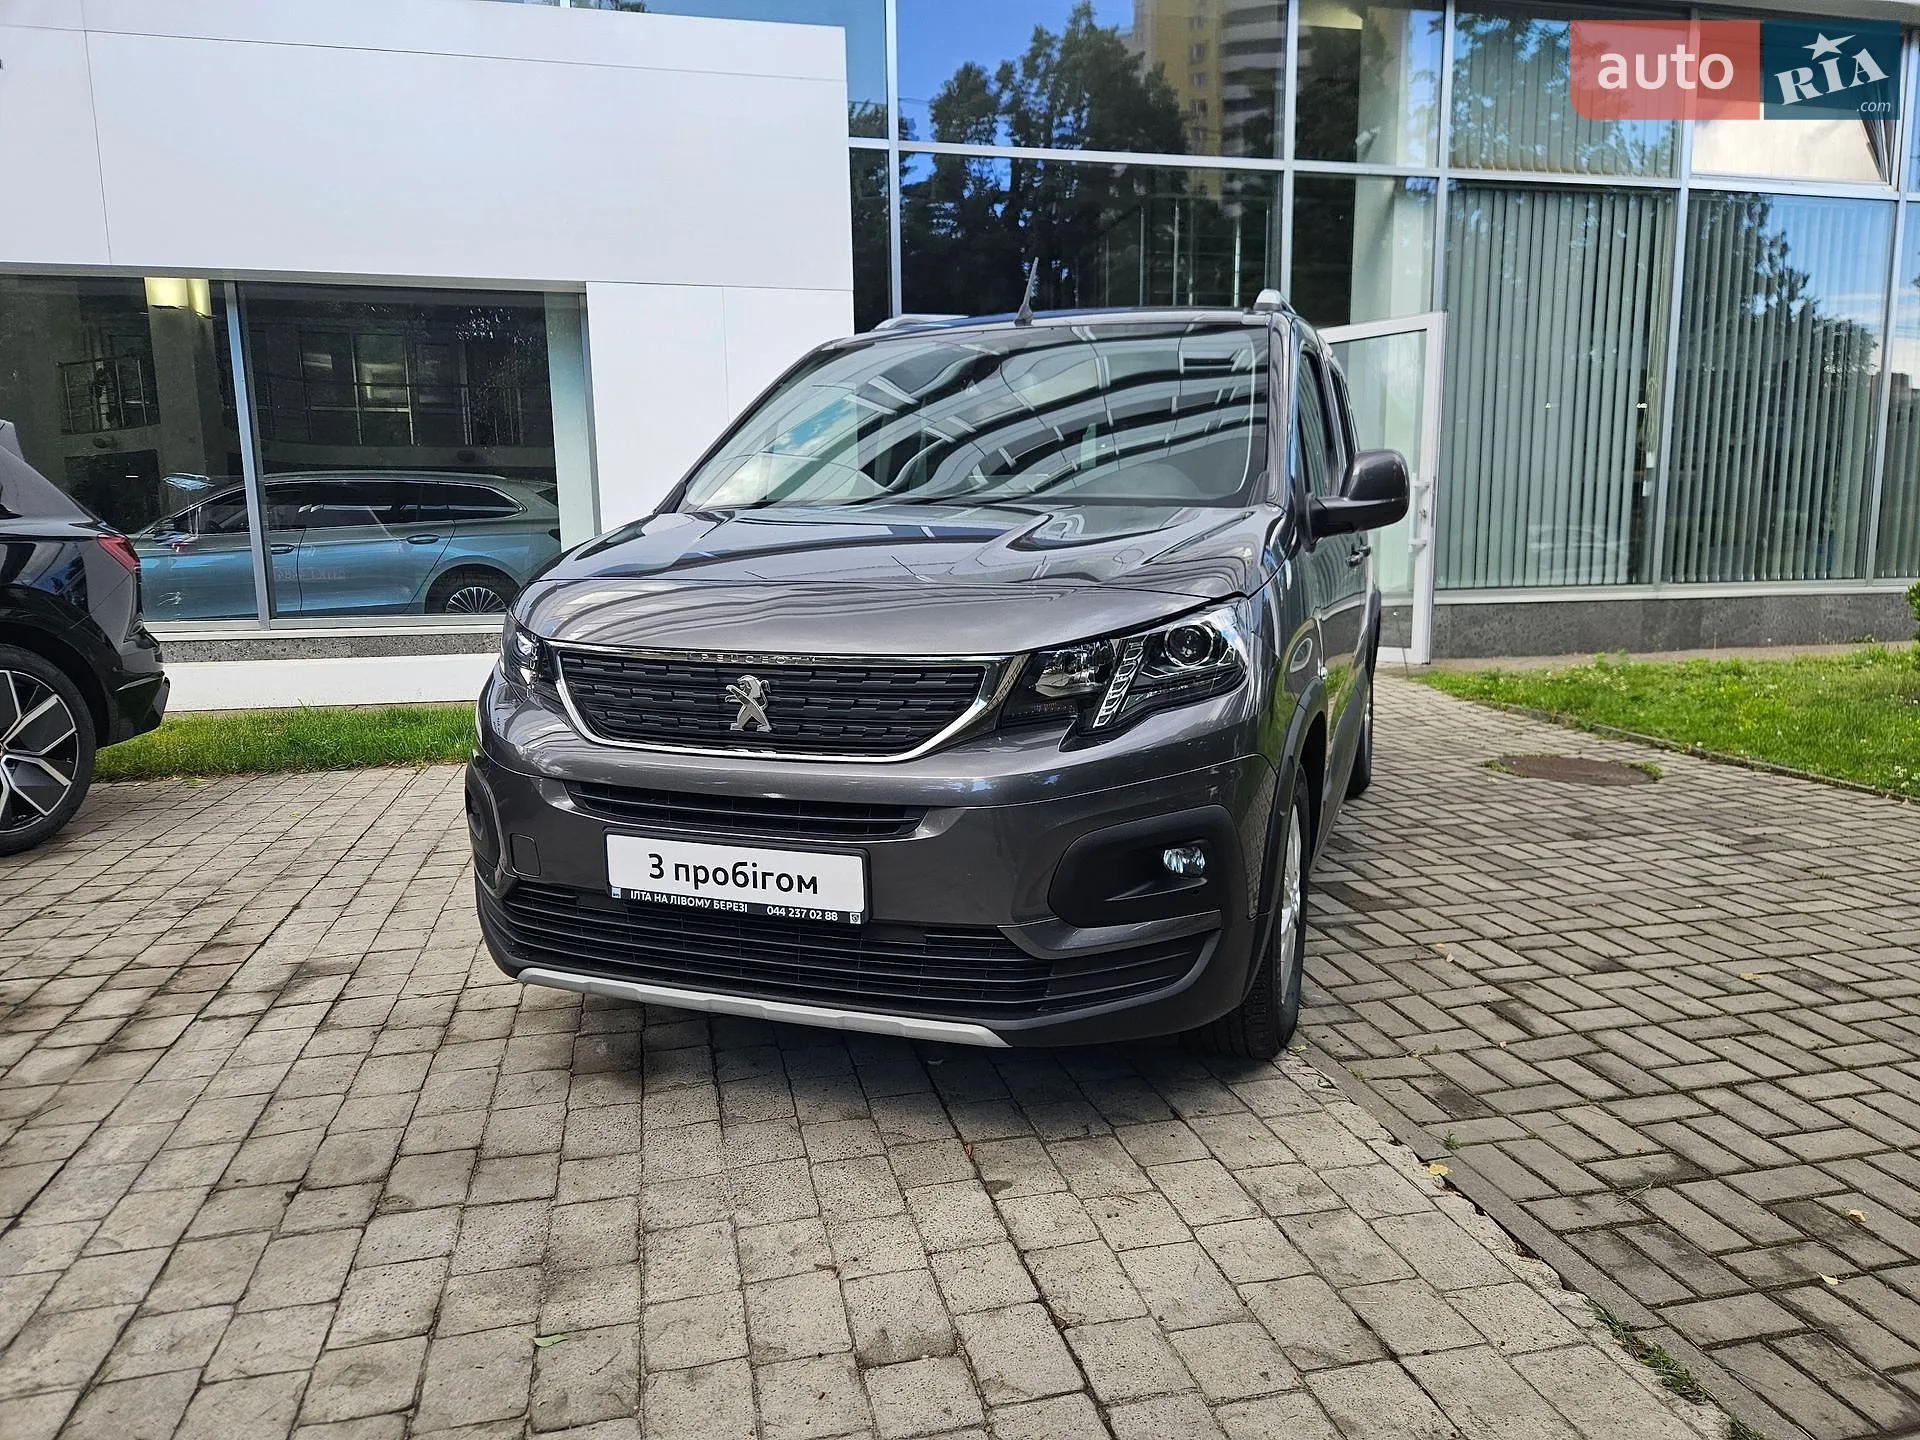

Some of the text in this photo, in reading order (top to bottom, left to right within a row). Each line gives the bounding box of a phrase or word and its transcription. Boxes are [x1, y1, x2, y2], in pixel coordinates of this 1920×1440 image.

[675, 862, 817, 894] пробігом
[630, 891, 748, 912] ІЛТА НА ЛІВОМУ БЕРЕЗІ
[767, 906, 838, 921] 044 237 02 88
